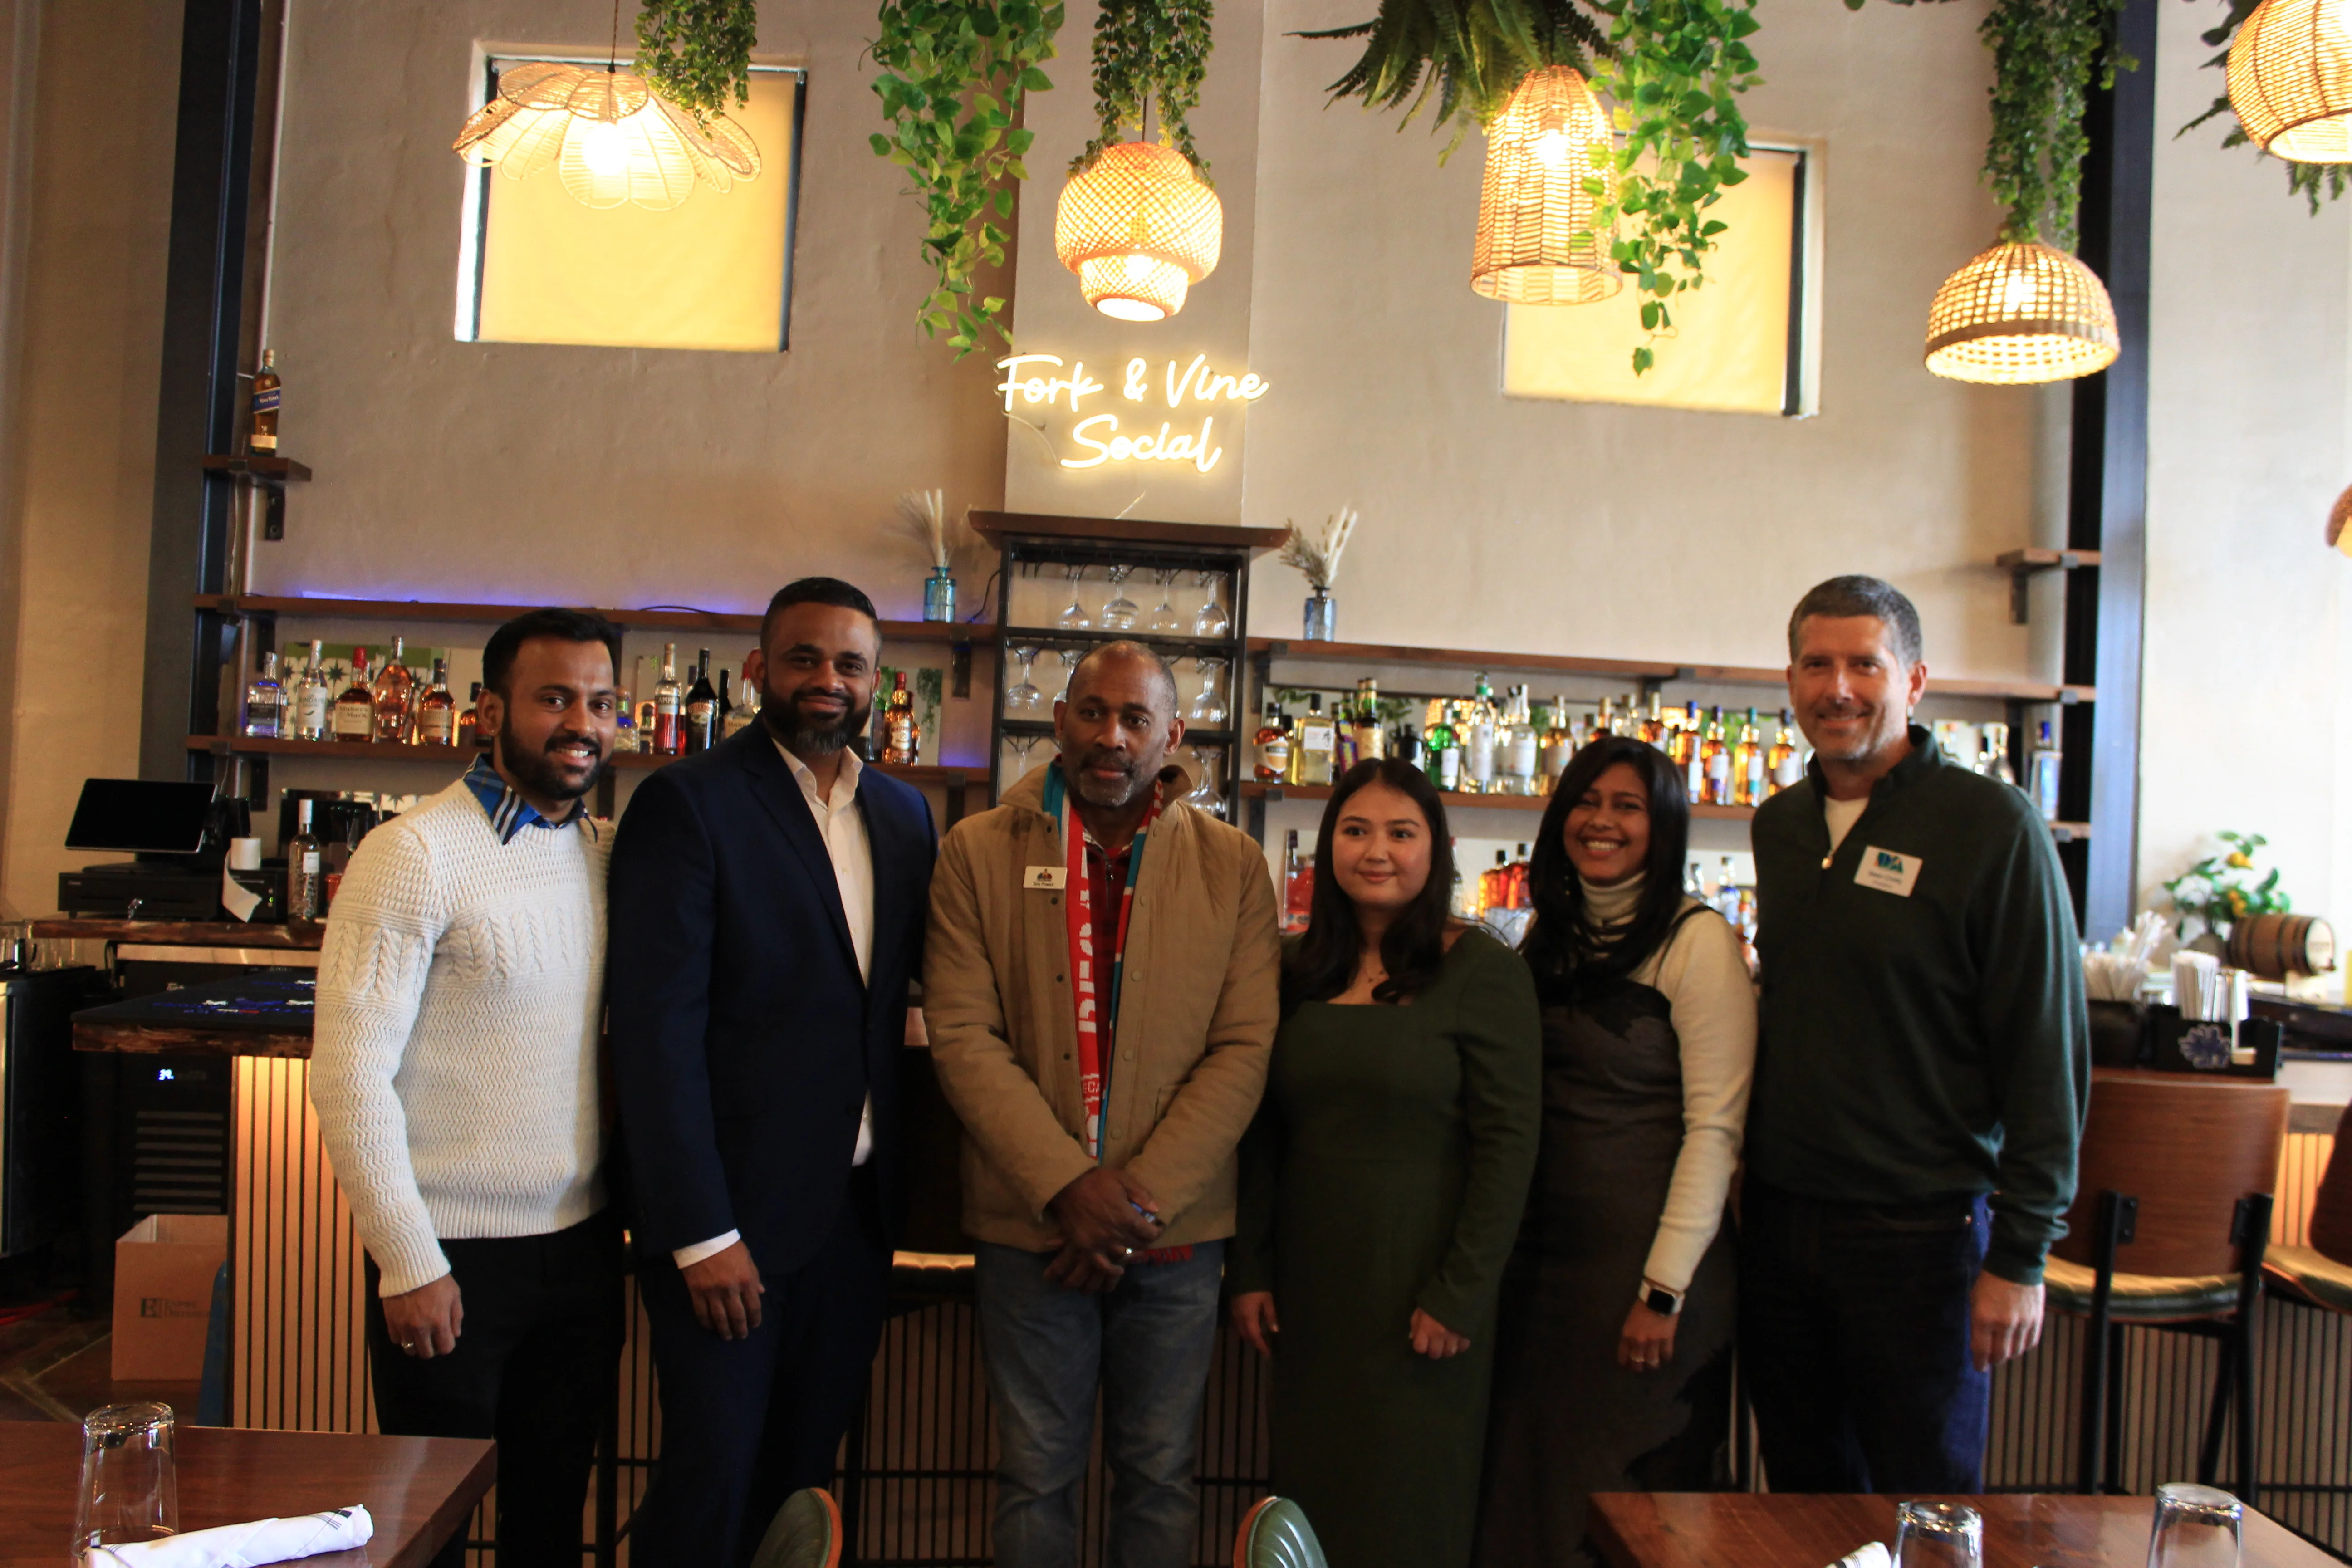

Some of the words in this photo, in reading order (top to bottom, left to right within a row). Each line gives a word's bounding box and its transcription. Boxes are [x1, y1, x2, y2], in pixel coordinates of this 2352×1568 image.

[997, 354, 1104, 412] Fork
[1123, 357, 1147, 402] &
[1166, 353, 1270, 408] Vine
[1060, 413, 1223, 473] Social
